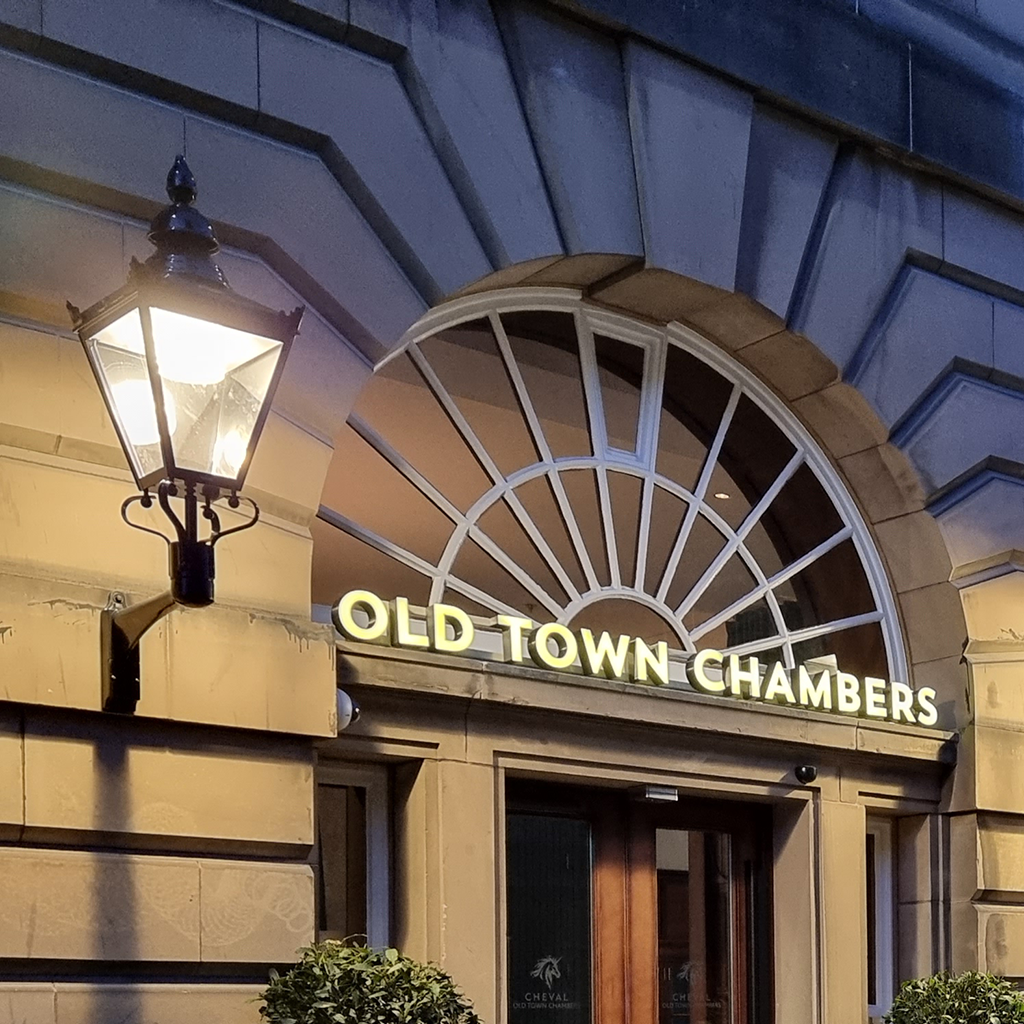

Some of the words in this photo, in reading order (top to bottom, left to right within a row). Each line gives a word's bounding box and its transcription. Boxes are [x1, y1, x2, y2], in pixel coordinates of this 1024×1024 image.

[334, 589, 475, 653] OLD
[498, 614, 670, 686] TOWN
[689, 648, 940, 727] CHAMBERS
[524, 992, 569, 1002] CHEVAL
